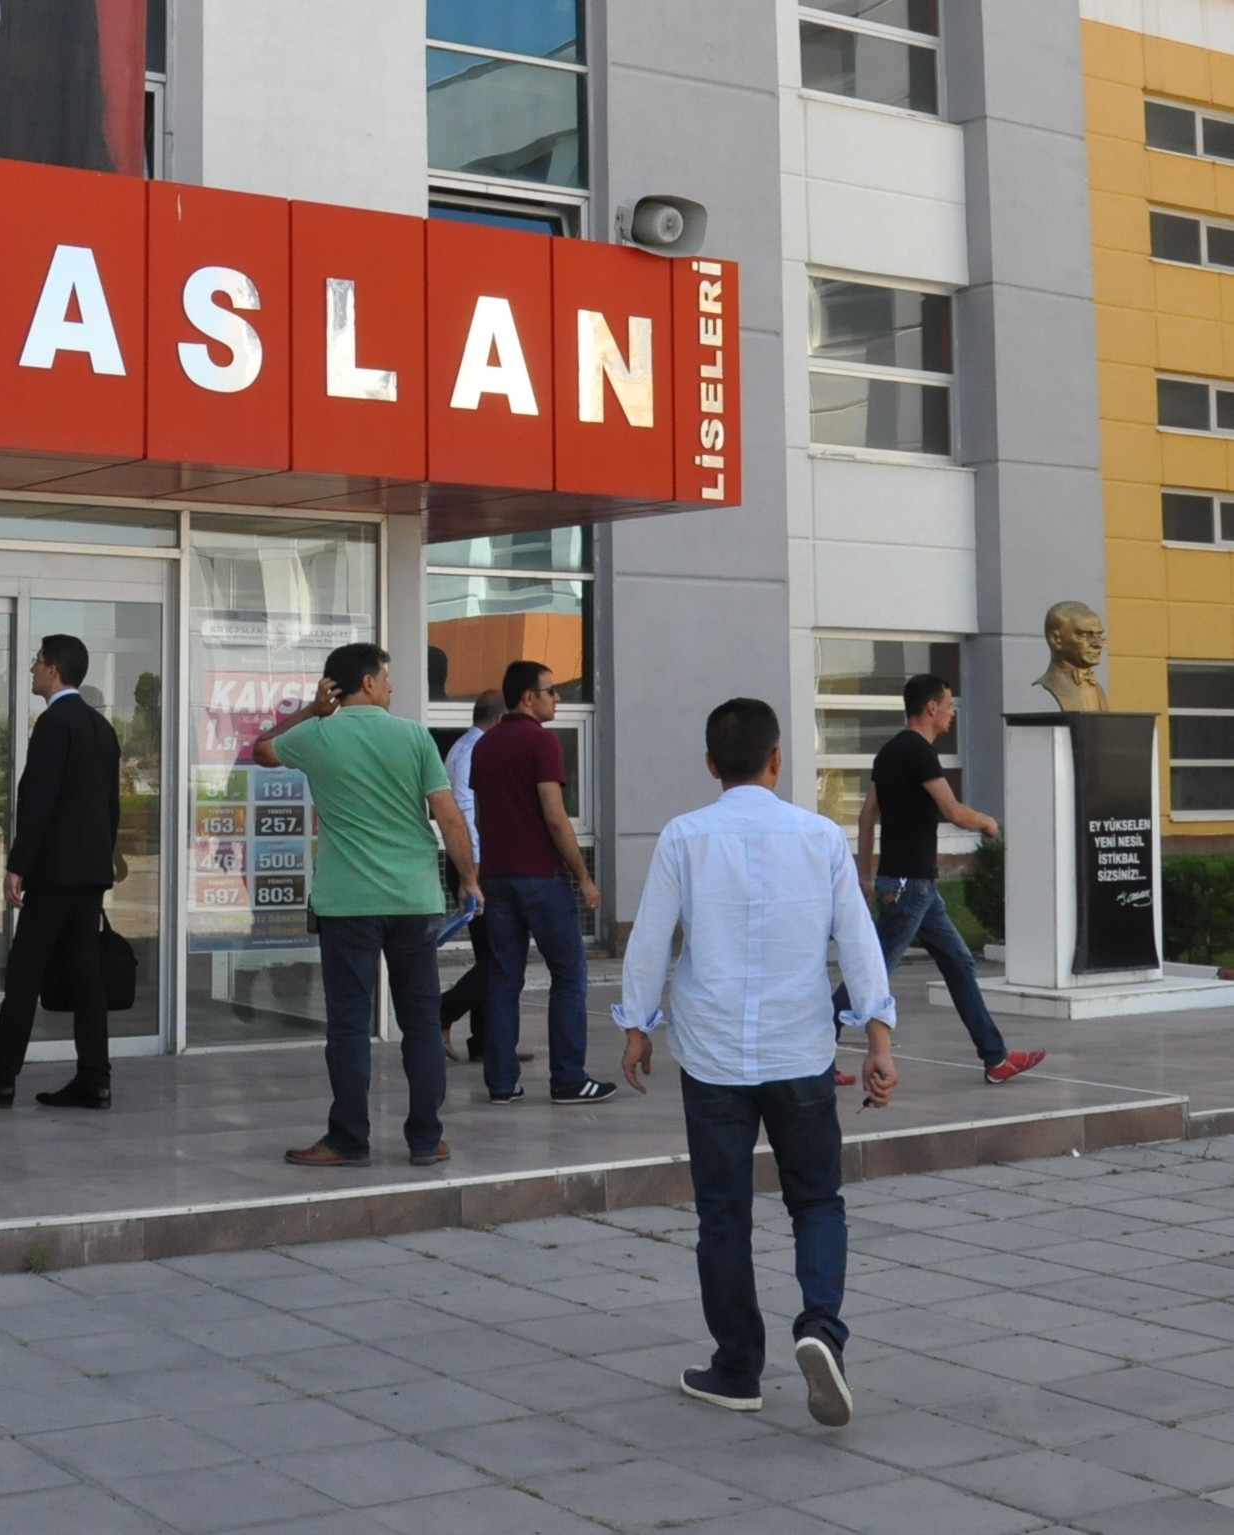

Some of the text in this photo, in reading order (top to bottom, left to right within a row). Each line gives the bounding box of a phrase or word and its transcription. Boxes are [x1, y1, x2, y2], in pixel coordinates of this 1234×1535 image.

[692, 260, 725, 501] LİSELERİ
[262, 782, 293, 797] 131
[202, 817, 234, 833] 153
[261, 817, 297, 833] 257
[1089, 817, 1151, 832] EY YÜKSELEN
[1094, 833, 1145, 848] YENİ NESİL
[259, 853, 296, 869] 500
[1098, 851, 1140, 865] İSTİKBAL
[203, 888, 239, 904] 597
[258, 887, 294, 903] 803
